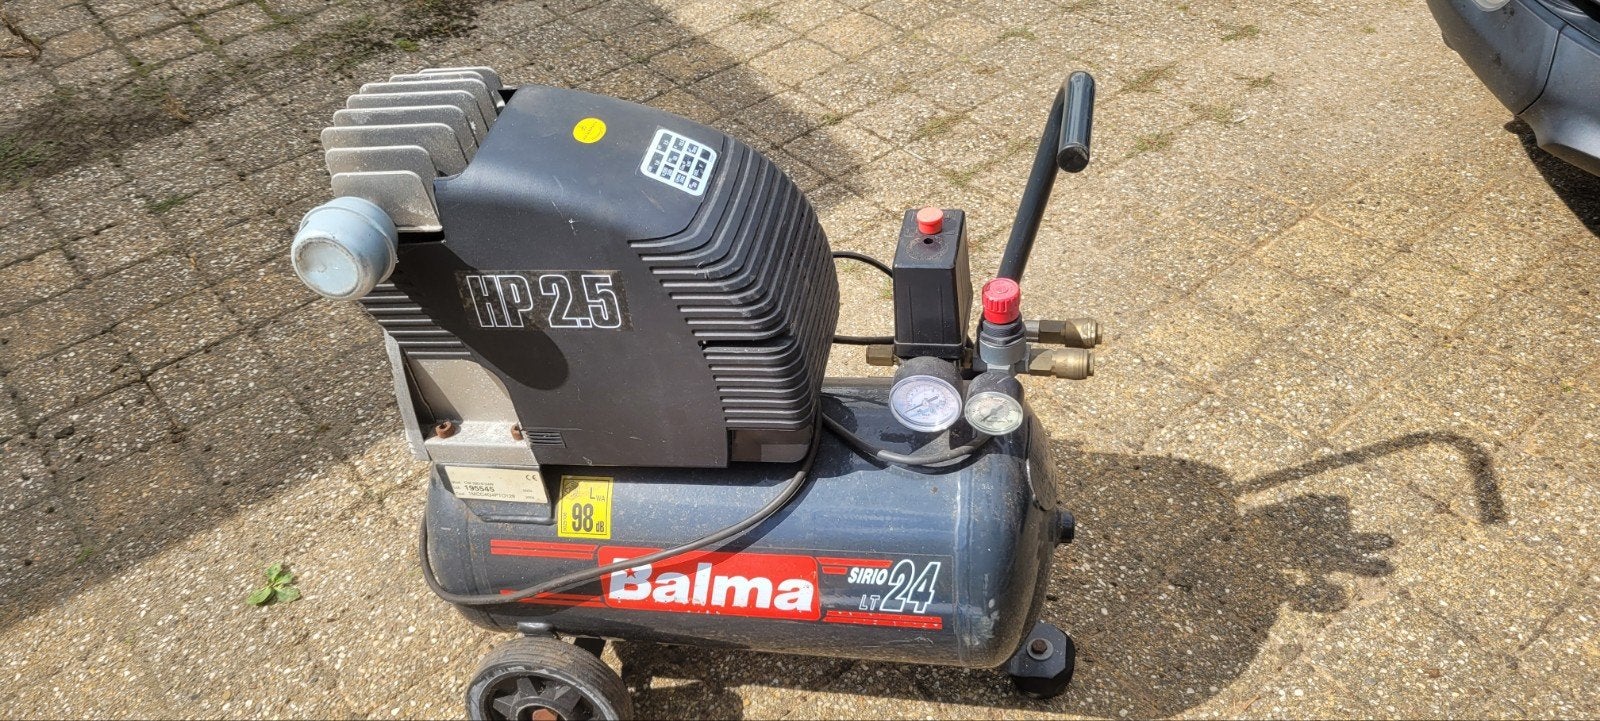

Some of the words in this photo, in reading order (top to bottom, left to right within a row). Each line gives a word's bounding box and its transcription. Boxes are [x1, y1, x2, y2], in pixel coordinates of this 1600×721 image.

[466, 274, 533, 328] HP
[539, 274, 622, 329] 2.5
[464, 485, 496, 493] 195545
[572, 502, 594, 532] 98
[596, 520, 605, 532] dB
[607, 558, 813, 613] Balma
[847, 566, 888, 586] SIRIO
[884, 558, 941, 614] 24
[859, 594, 881, 611] LT
